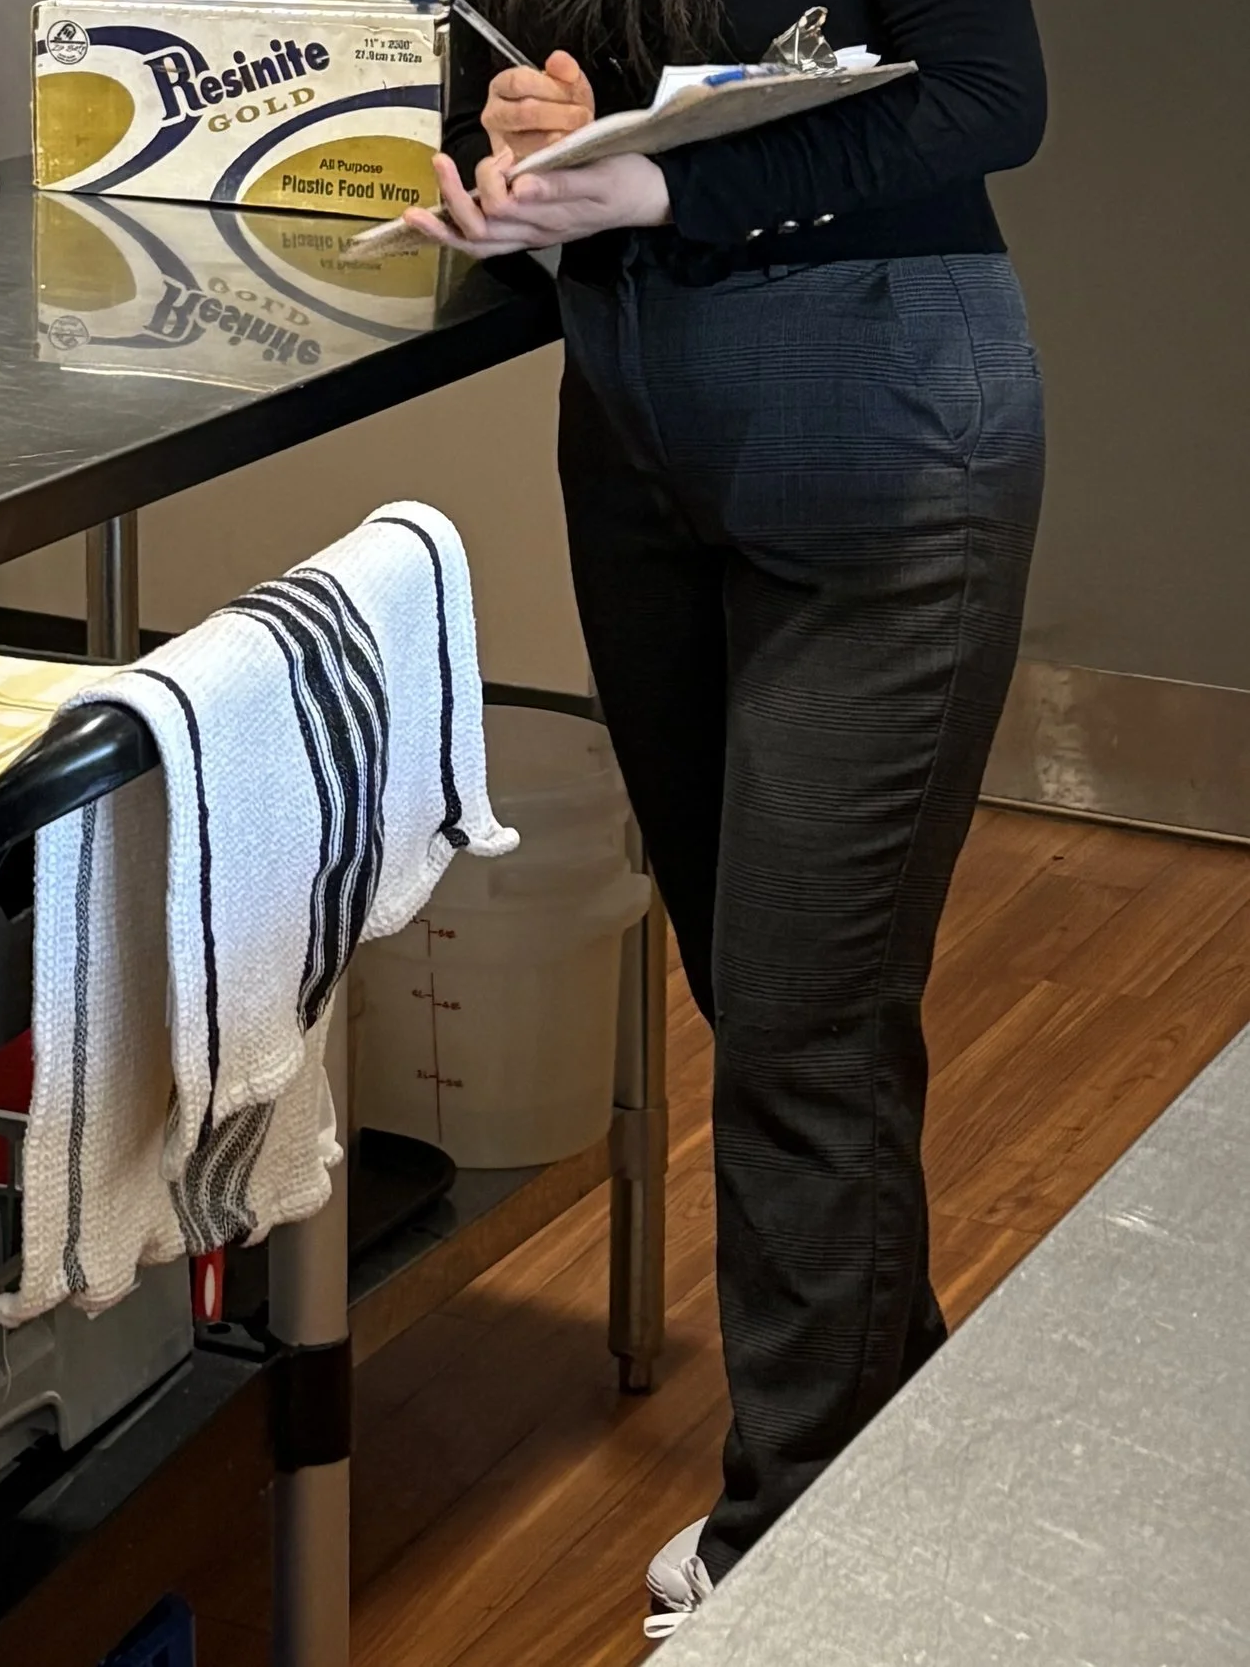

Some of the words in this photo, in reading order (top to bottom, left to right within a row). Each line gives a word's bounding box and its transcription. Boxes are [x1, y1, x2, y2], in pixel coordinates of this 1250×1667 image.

[143, 39, 331, 120] Resinite
[208, 87, 315, 132] GOLD
[319, 158, 335, 170] All
[337, 160, 383, 174] Purpose
[282, 175, 334, 196] Plastic
[338, 179, 374, 199] Food
[380, 183, 420, 206] Wrap
